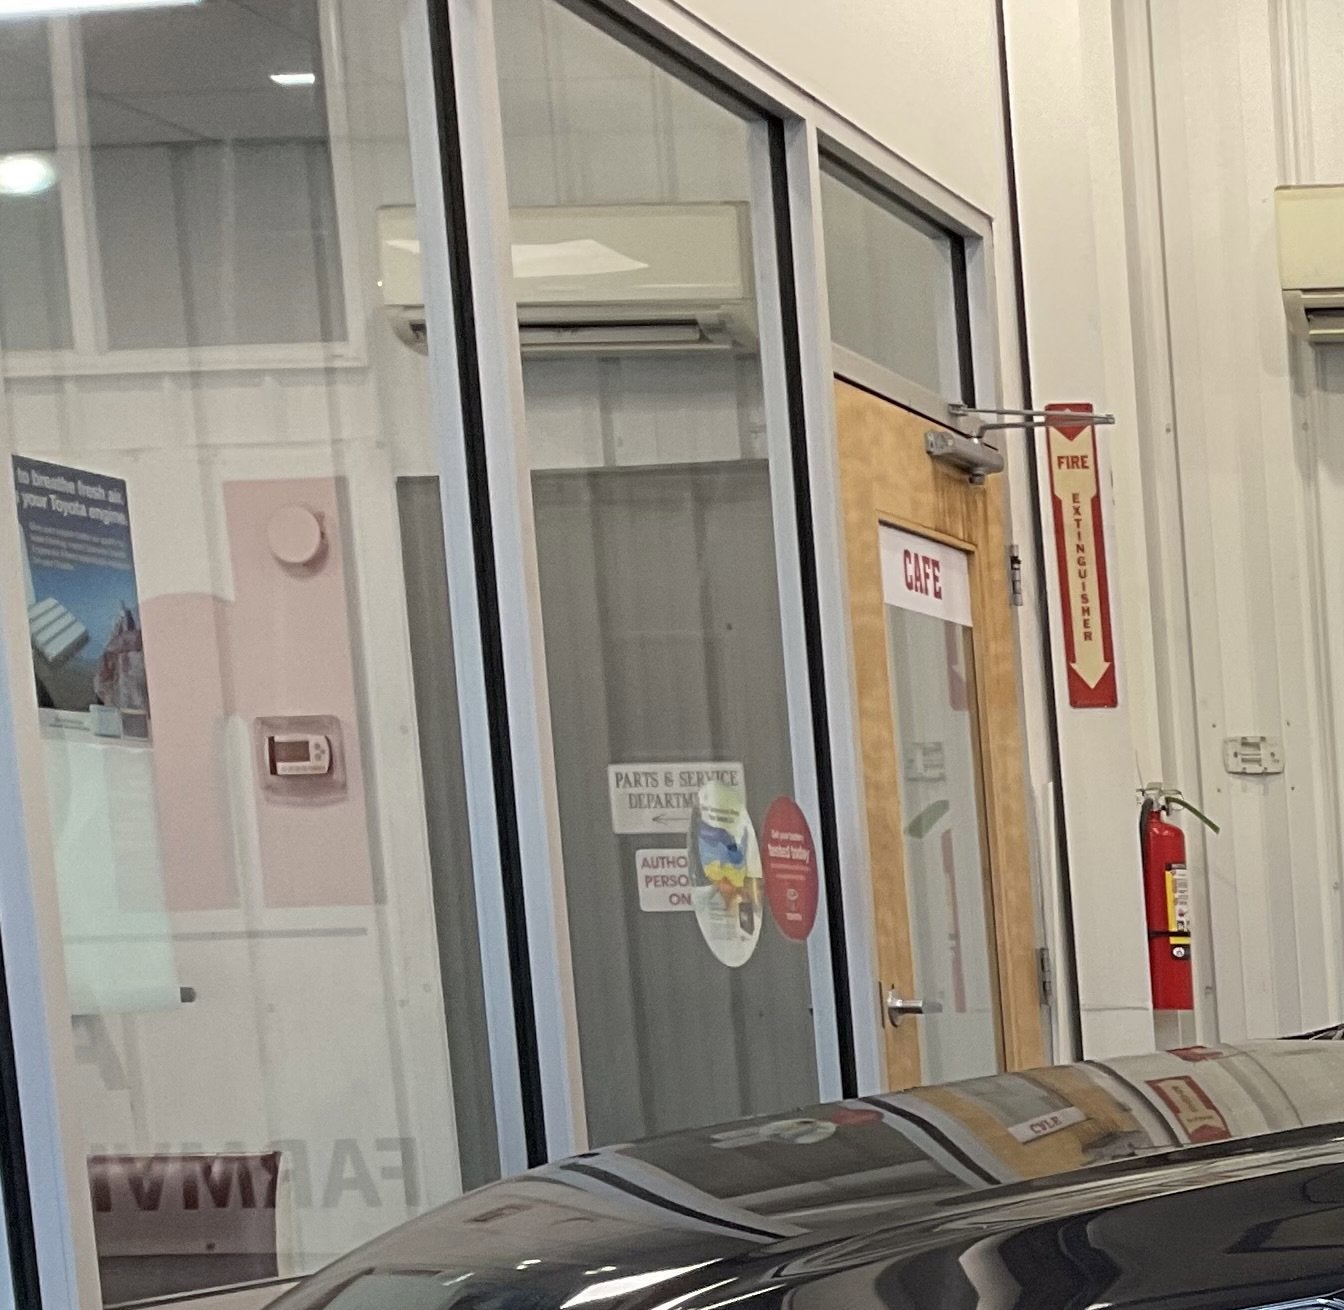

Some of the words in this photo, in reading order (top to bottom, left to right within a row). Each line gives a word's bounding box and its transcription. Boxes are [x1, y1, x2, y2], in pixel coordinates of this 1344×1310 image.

[1057, 455, 1090, 470] FIRE
[49, 494, 87, 516] Toyota
[903, 549, 943, 600] CAFE
[1072, 493, 1093, 642] EXTINGUISHER
[615, 771, 658, 788] PARTS
[664, 771, 674, 786] &
[680, 770, 739, 787] SERVICE
[628, 792, 700, 809] DEPARTM
[641, 856, 688, 869] AUTHO
[645, 875, 690, 889] PERSO
[669, 893, 692, 906] ON
